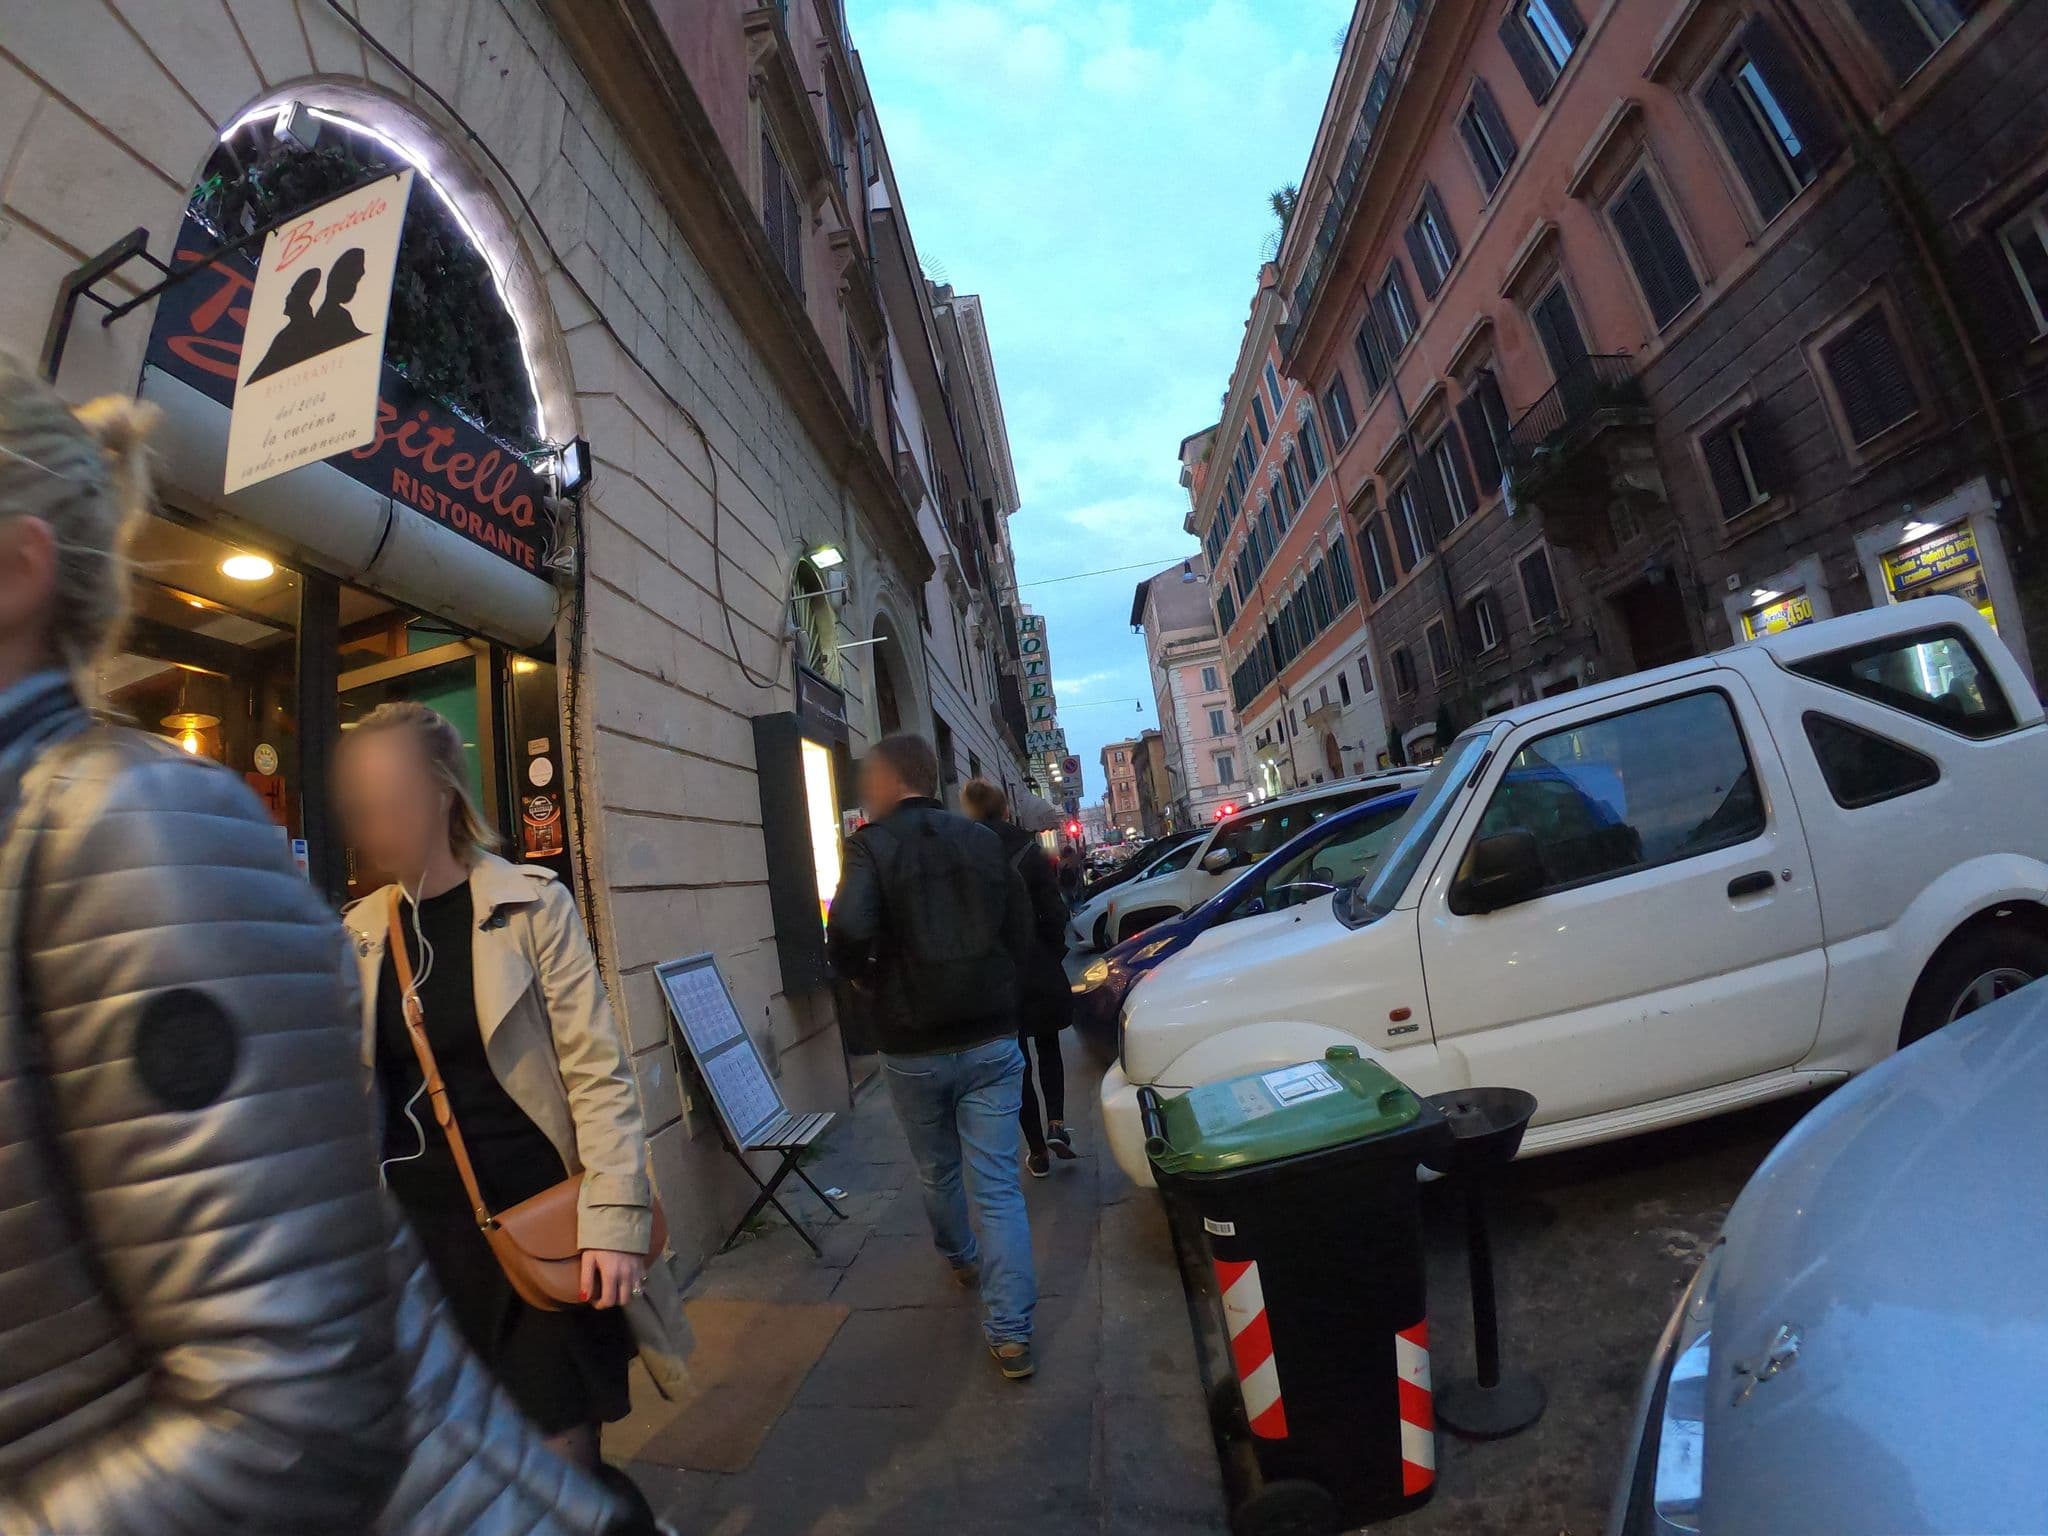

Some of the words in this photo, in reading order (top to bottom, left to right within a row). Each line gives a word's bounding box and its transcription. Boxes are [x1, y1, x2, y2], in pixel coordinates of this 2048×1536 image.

[262, 426, 277, 450] la
[283, 412, 336, 441] cucina
[391, 467, 536, 570] RISTORANTE
[1020, 616, 1052, 722] HOTEL
[1027, 730, 1064, 745] ZARA
